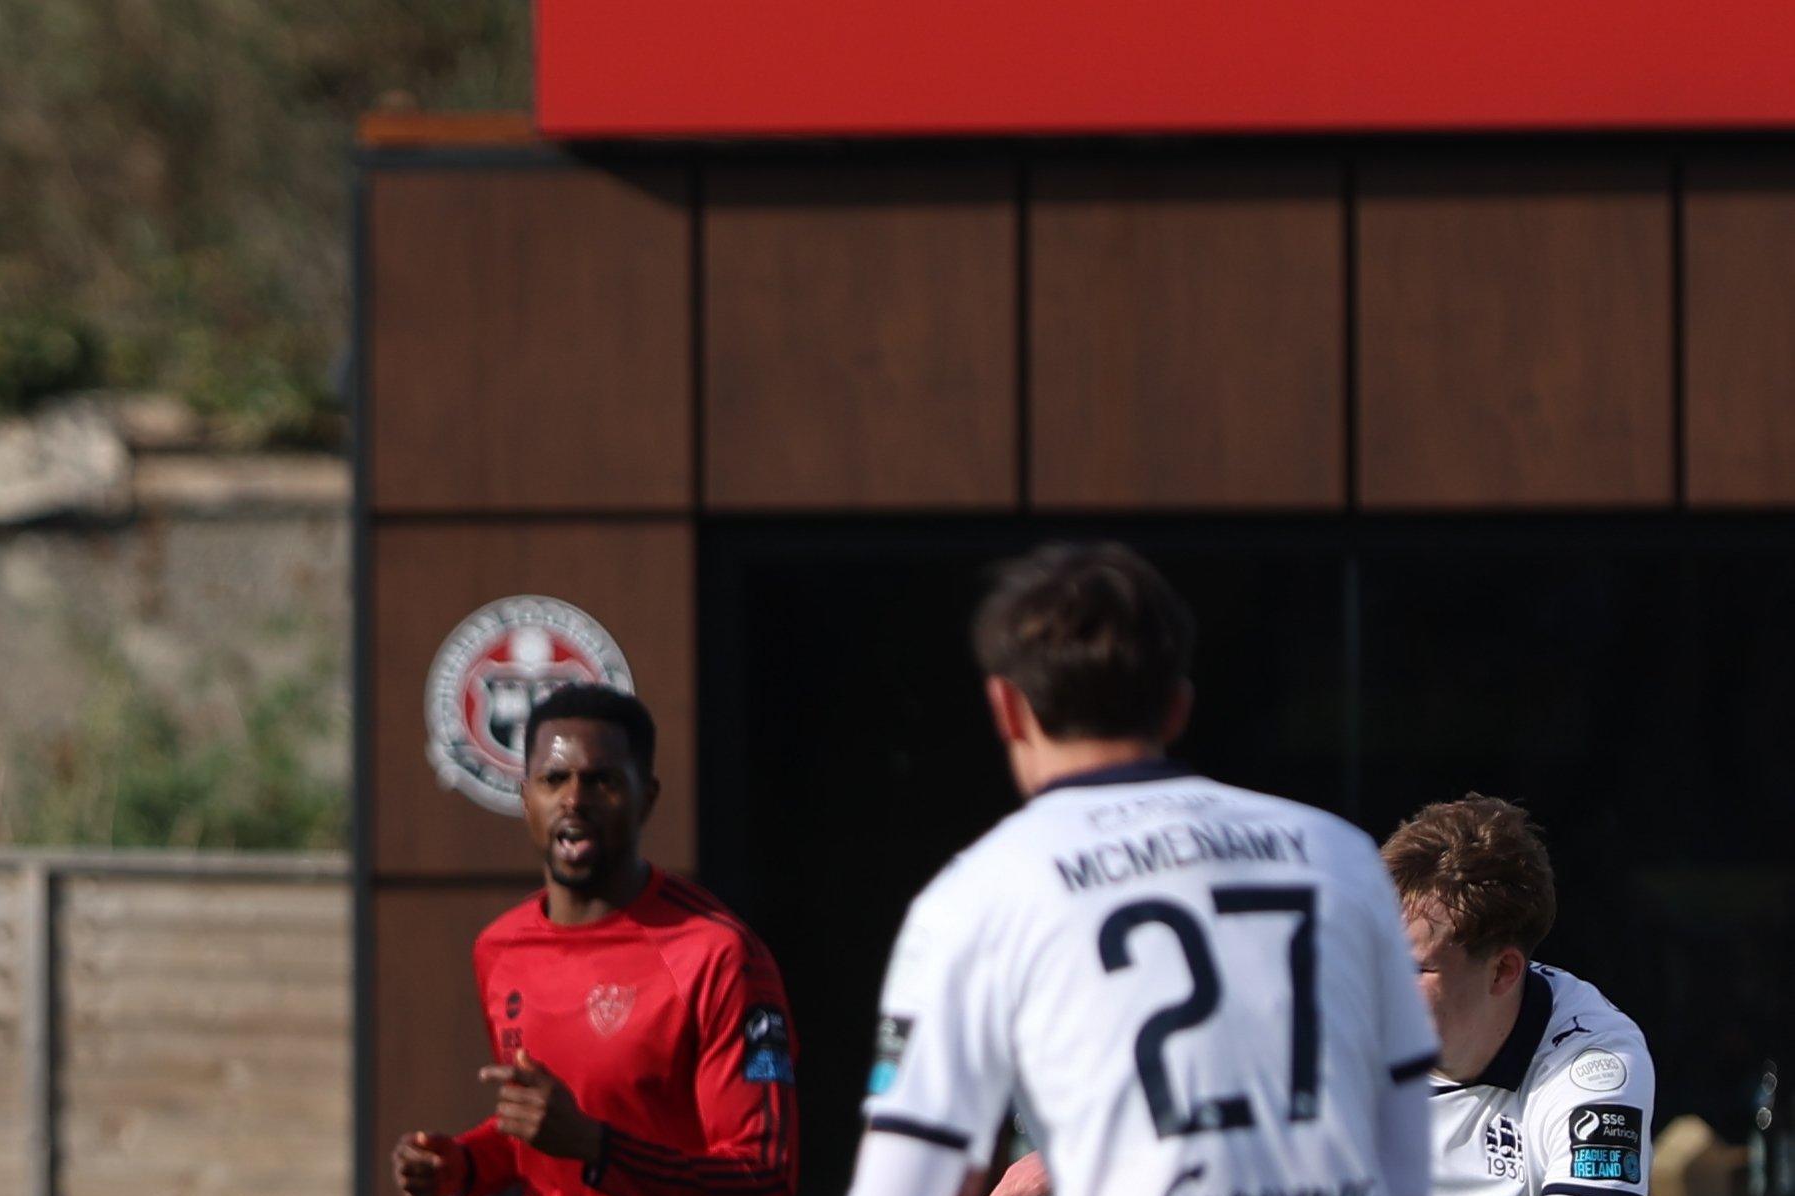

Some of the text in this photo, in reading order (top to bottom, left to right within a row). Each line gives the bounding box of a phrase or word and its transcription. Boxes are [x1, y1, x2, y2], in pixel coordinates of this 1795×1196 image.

[1098, 886, 1320, 1140] 27
[1575, 1058, 1620, 1078] COPPERS
[1602, 1113, 1625, 1125] sse
[1603, 1126, 1639, 1143] Airtricity
[1575, 1148, 1622, 1163] LEAGUE OF
[1487, 1156, 1526, 1184] 1930
[1574, 1162, 1622, 1178] IRELAND
